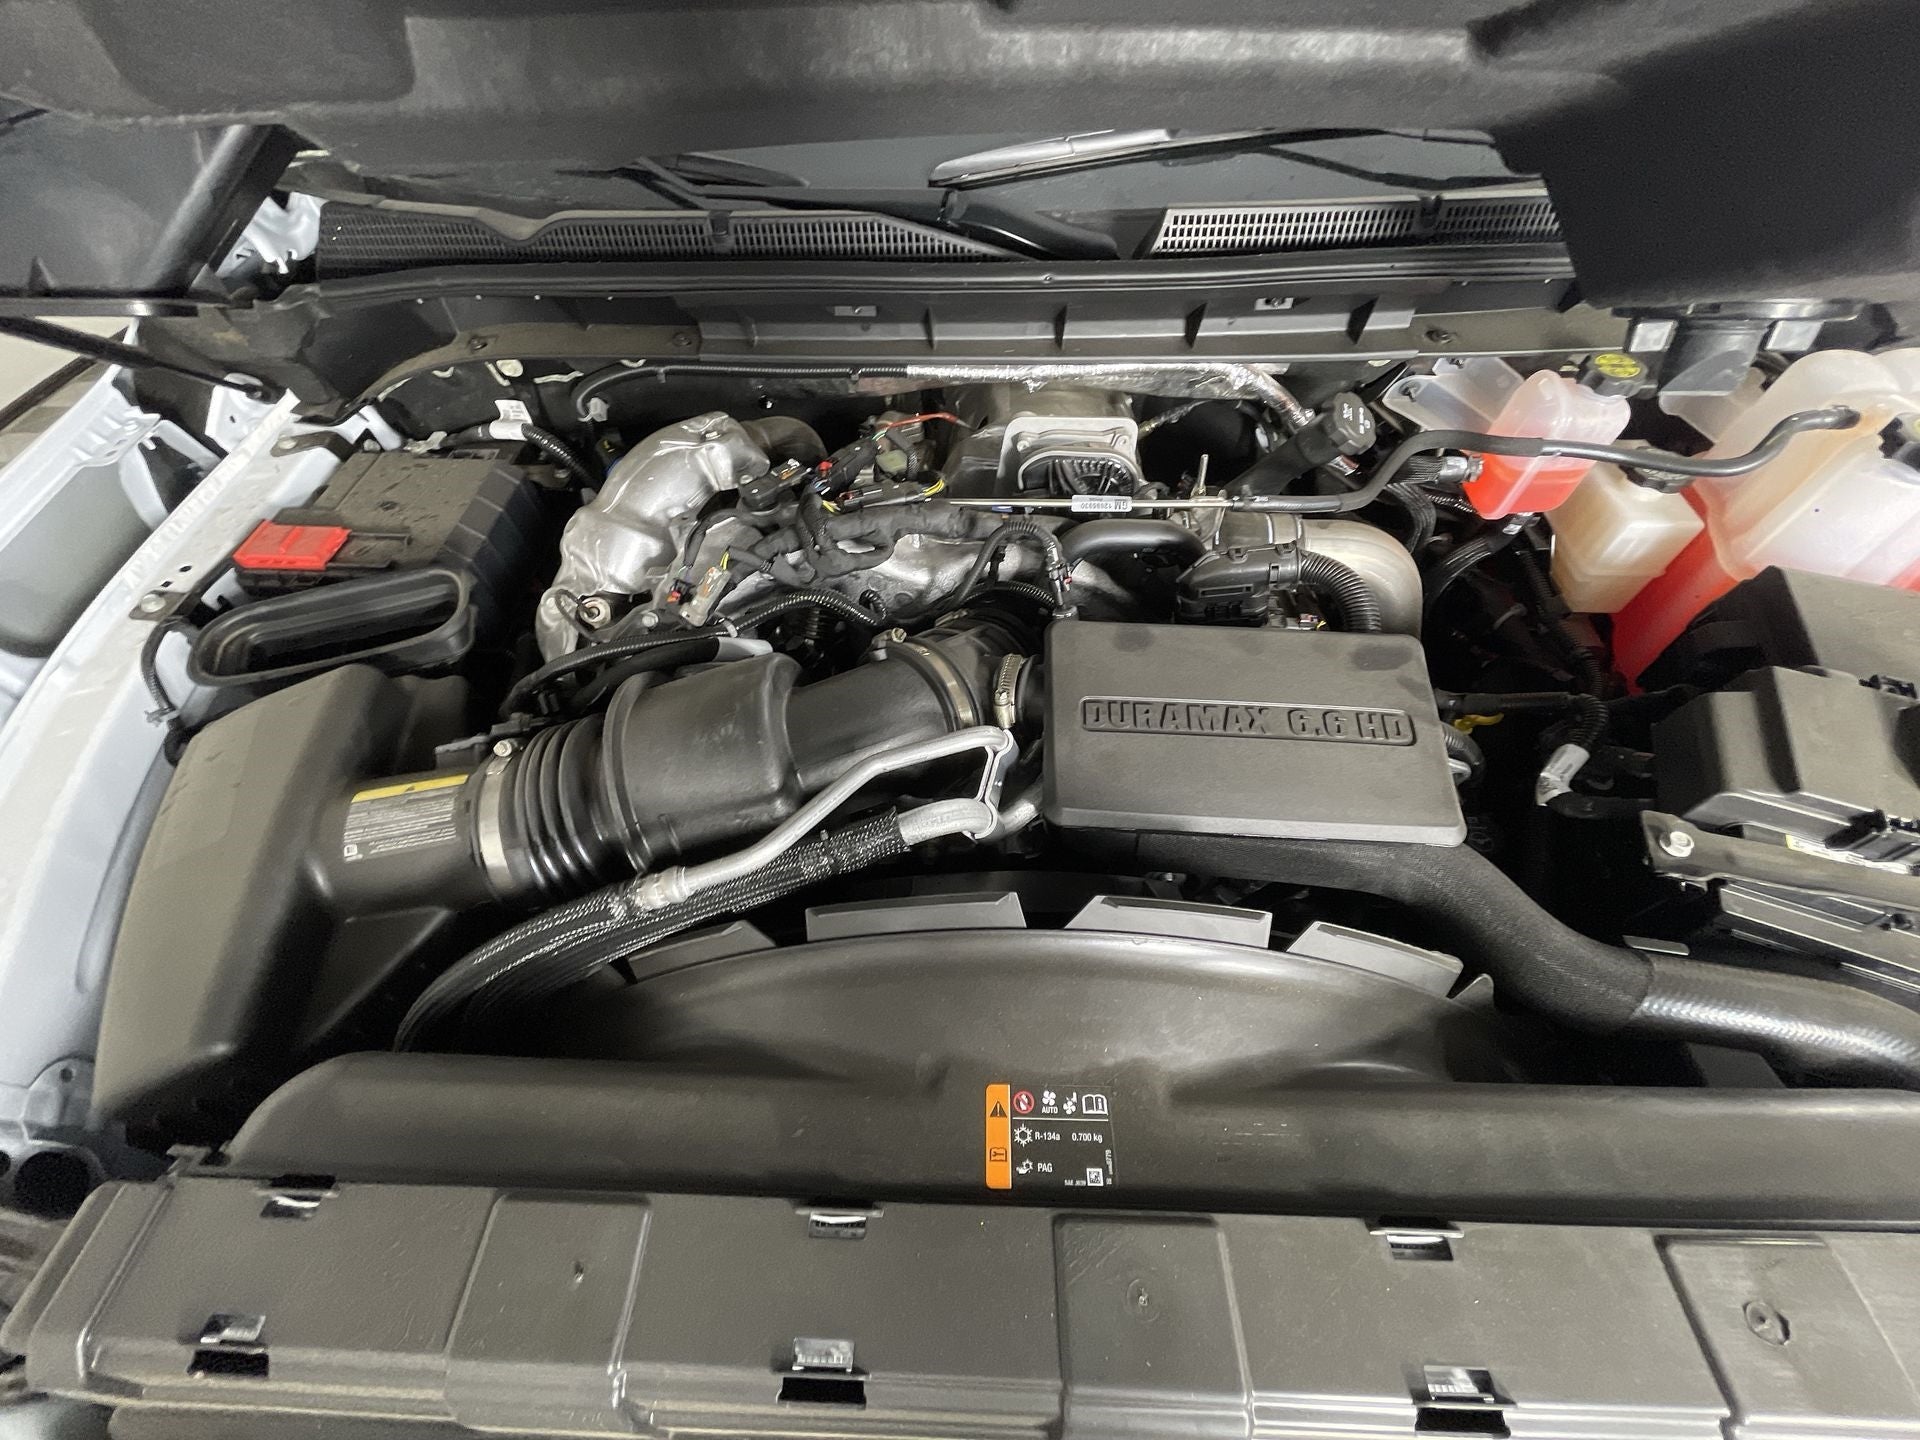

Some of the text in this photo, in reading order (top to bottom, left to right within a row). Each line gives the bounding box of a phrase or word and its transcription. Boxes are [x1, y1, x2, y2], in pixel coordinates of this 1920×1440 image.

[1114, 500, 1128, 510] GM
[1083, 701, 1412, 741] DURAMAX 6.6 HD
[1041, 1106, 1058, 1114] AUTO
[1035, 1132, 1103, 1144] R-134a 0.700 kg
[1037, 1162, 1053, 1173] PAG
